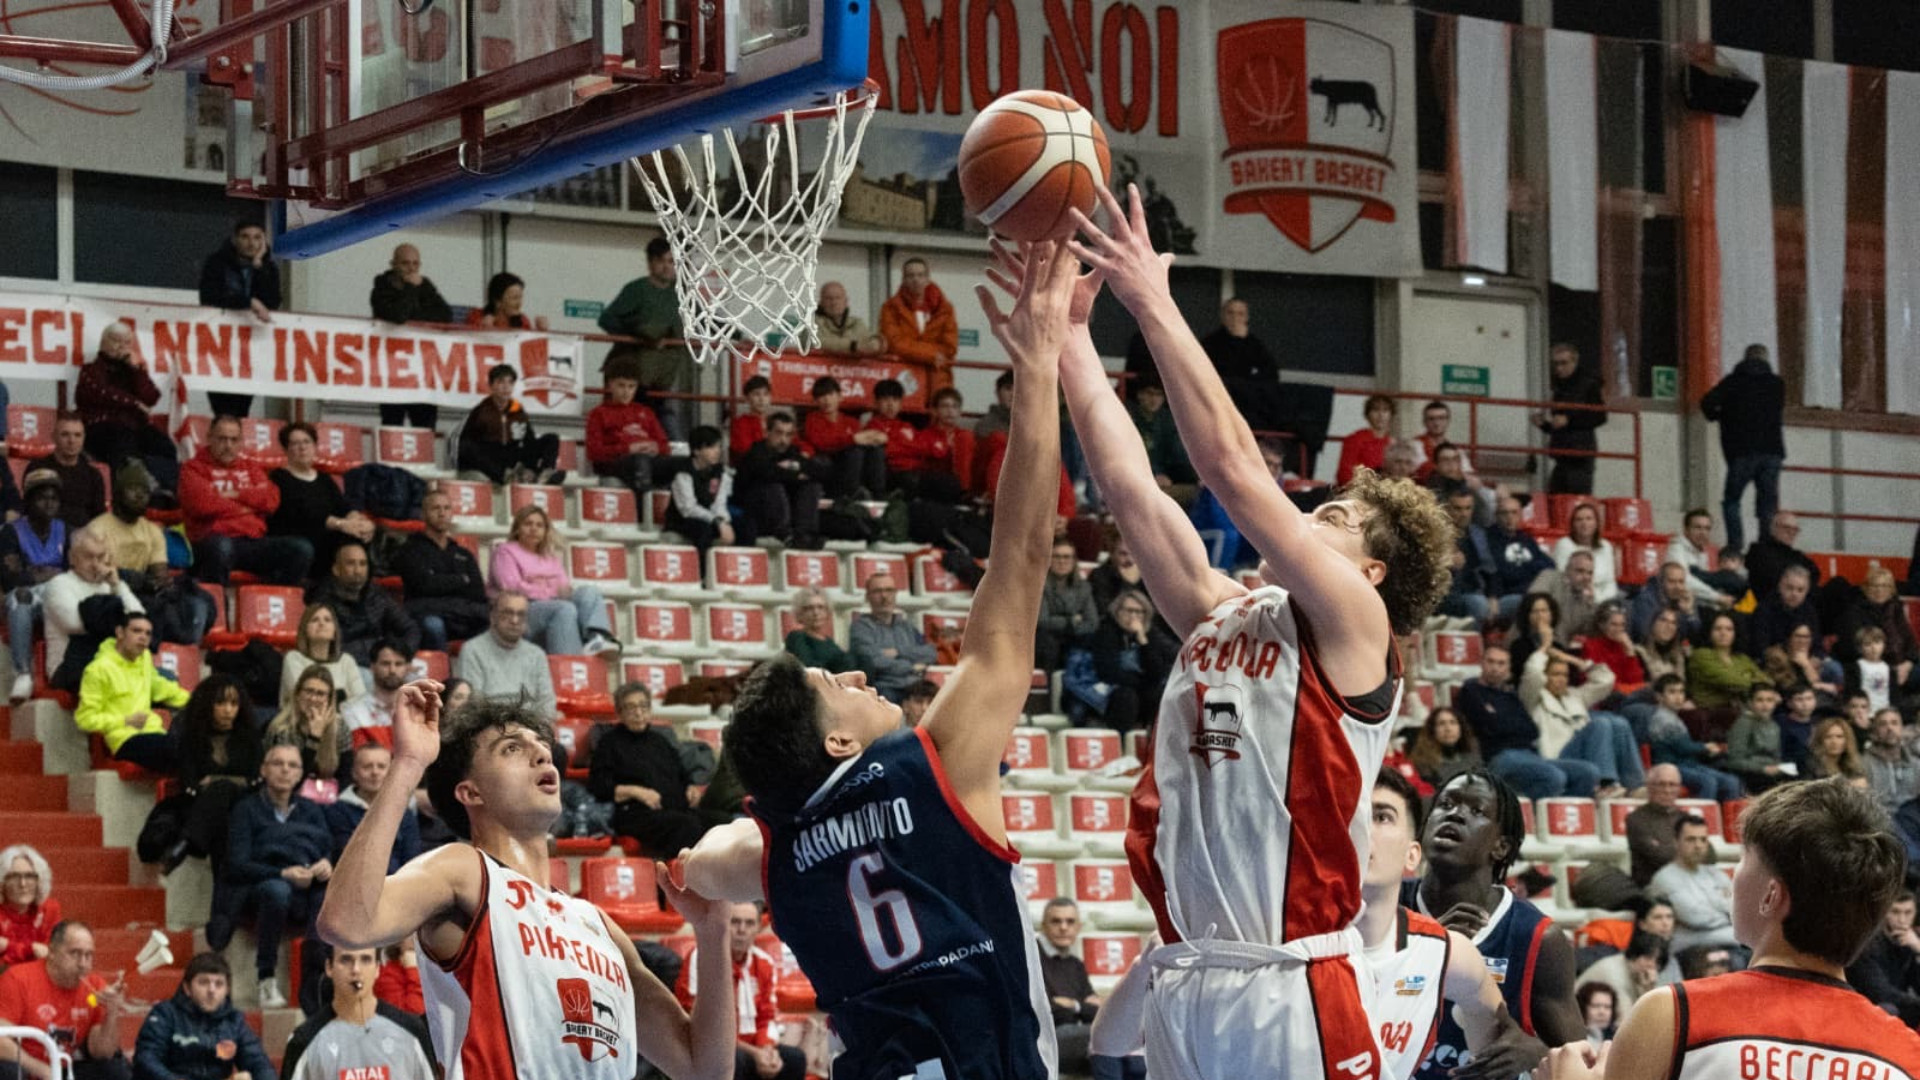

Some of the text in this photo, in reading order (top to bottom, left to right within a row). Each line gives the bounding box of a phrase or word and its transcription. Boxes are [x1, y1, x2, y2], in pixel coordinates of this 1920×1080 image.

[1044, 0, 1178, 136] NOI
[1230, 157, 1385, 193] BAKERY BASKET
[846, 849, 923, 973] 6
